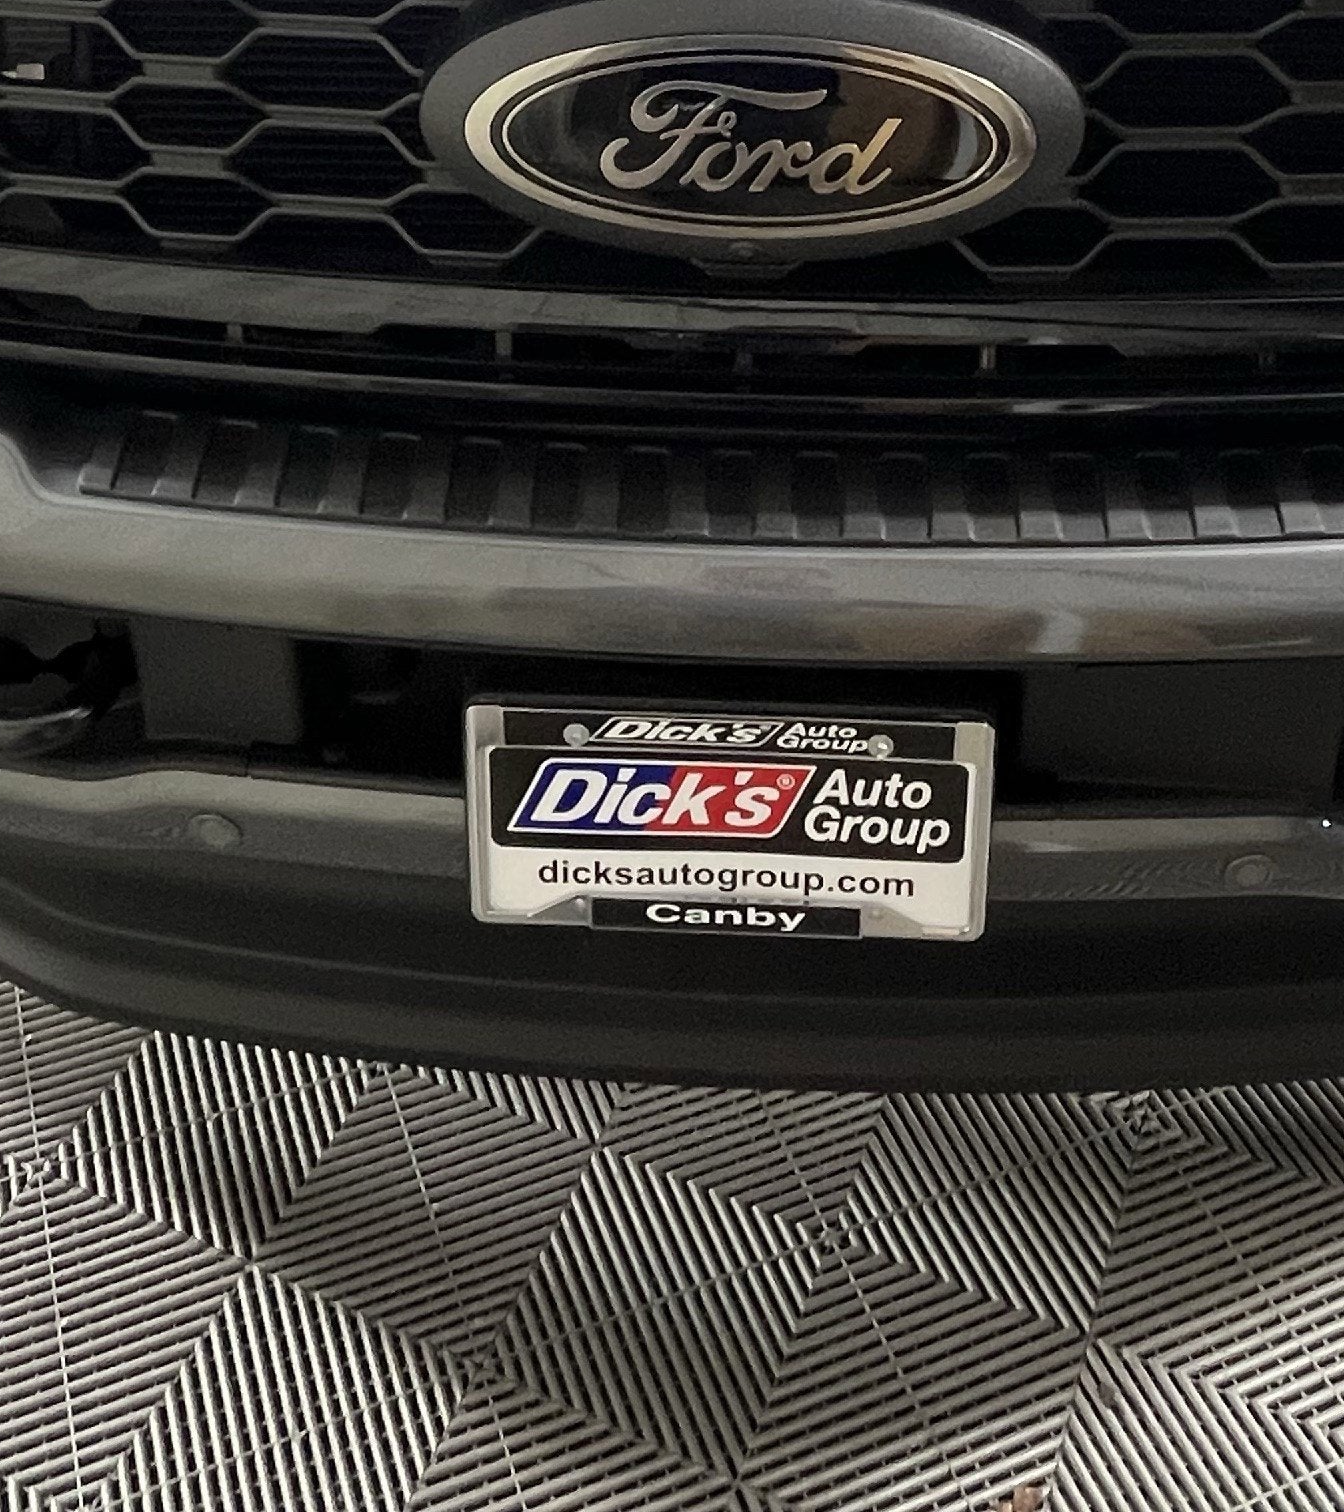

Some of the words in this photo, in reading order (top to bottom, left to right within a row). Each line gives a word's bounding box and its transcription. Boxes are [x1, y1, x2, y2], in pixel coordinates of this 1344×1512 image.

[600, 80, 903, 194] Ford
[603, 720, 763, 745] Dick's
[780, 722, 858, 739] Auto
[776, 736, 868, 755] Group
[812, 769, 933, 810] Auto
[804, 804, 951, 855] Group
[537, 859, 916, 898] dicksautogroup.com
[645, 903, 807, 932] Canby
